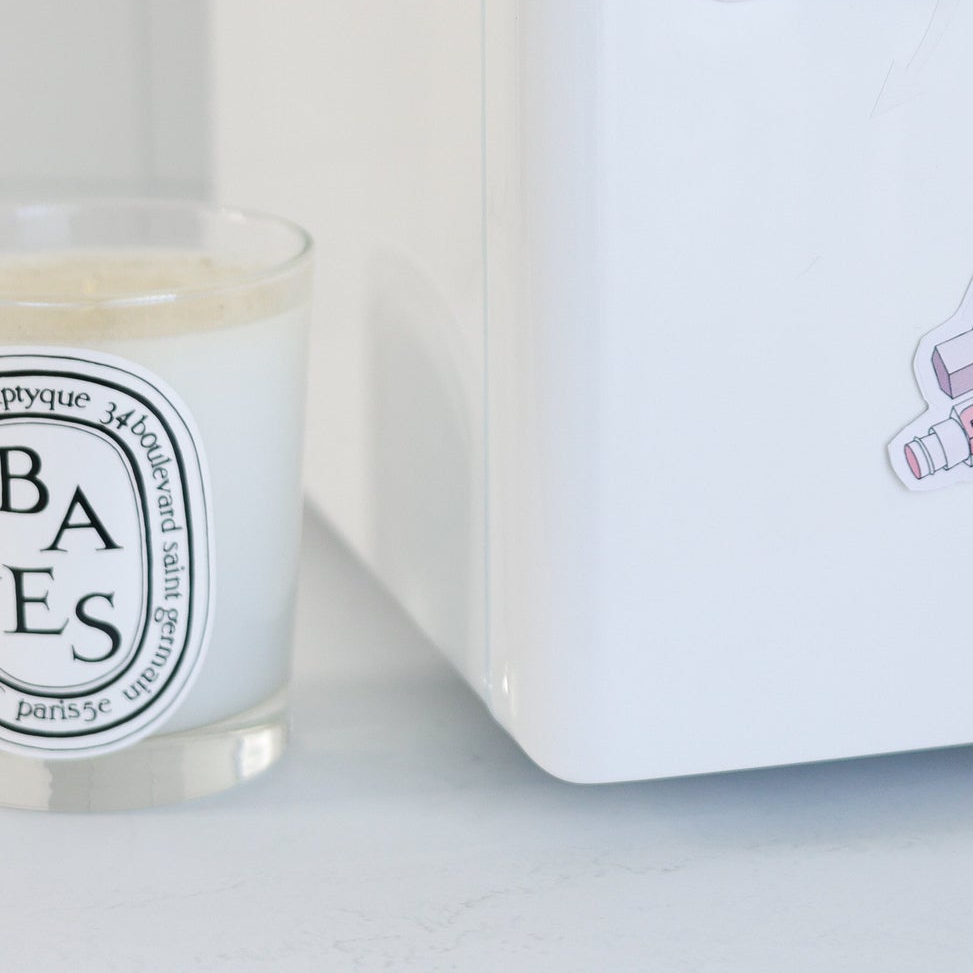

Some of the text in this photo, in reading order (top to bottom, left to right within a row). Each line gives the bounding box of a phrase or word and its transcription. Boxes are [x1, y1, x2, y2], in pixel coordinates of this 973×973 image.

[0, 385, 91, 411] ptyque
[163, 541, 186, 601] saint
[0, 563, 122, 663] ES
[122, 606, 179, 702] germain
